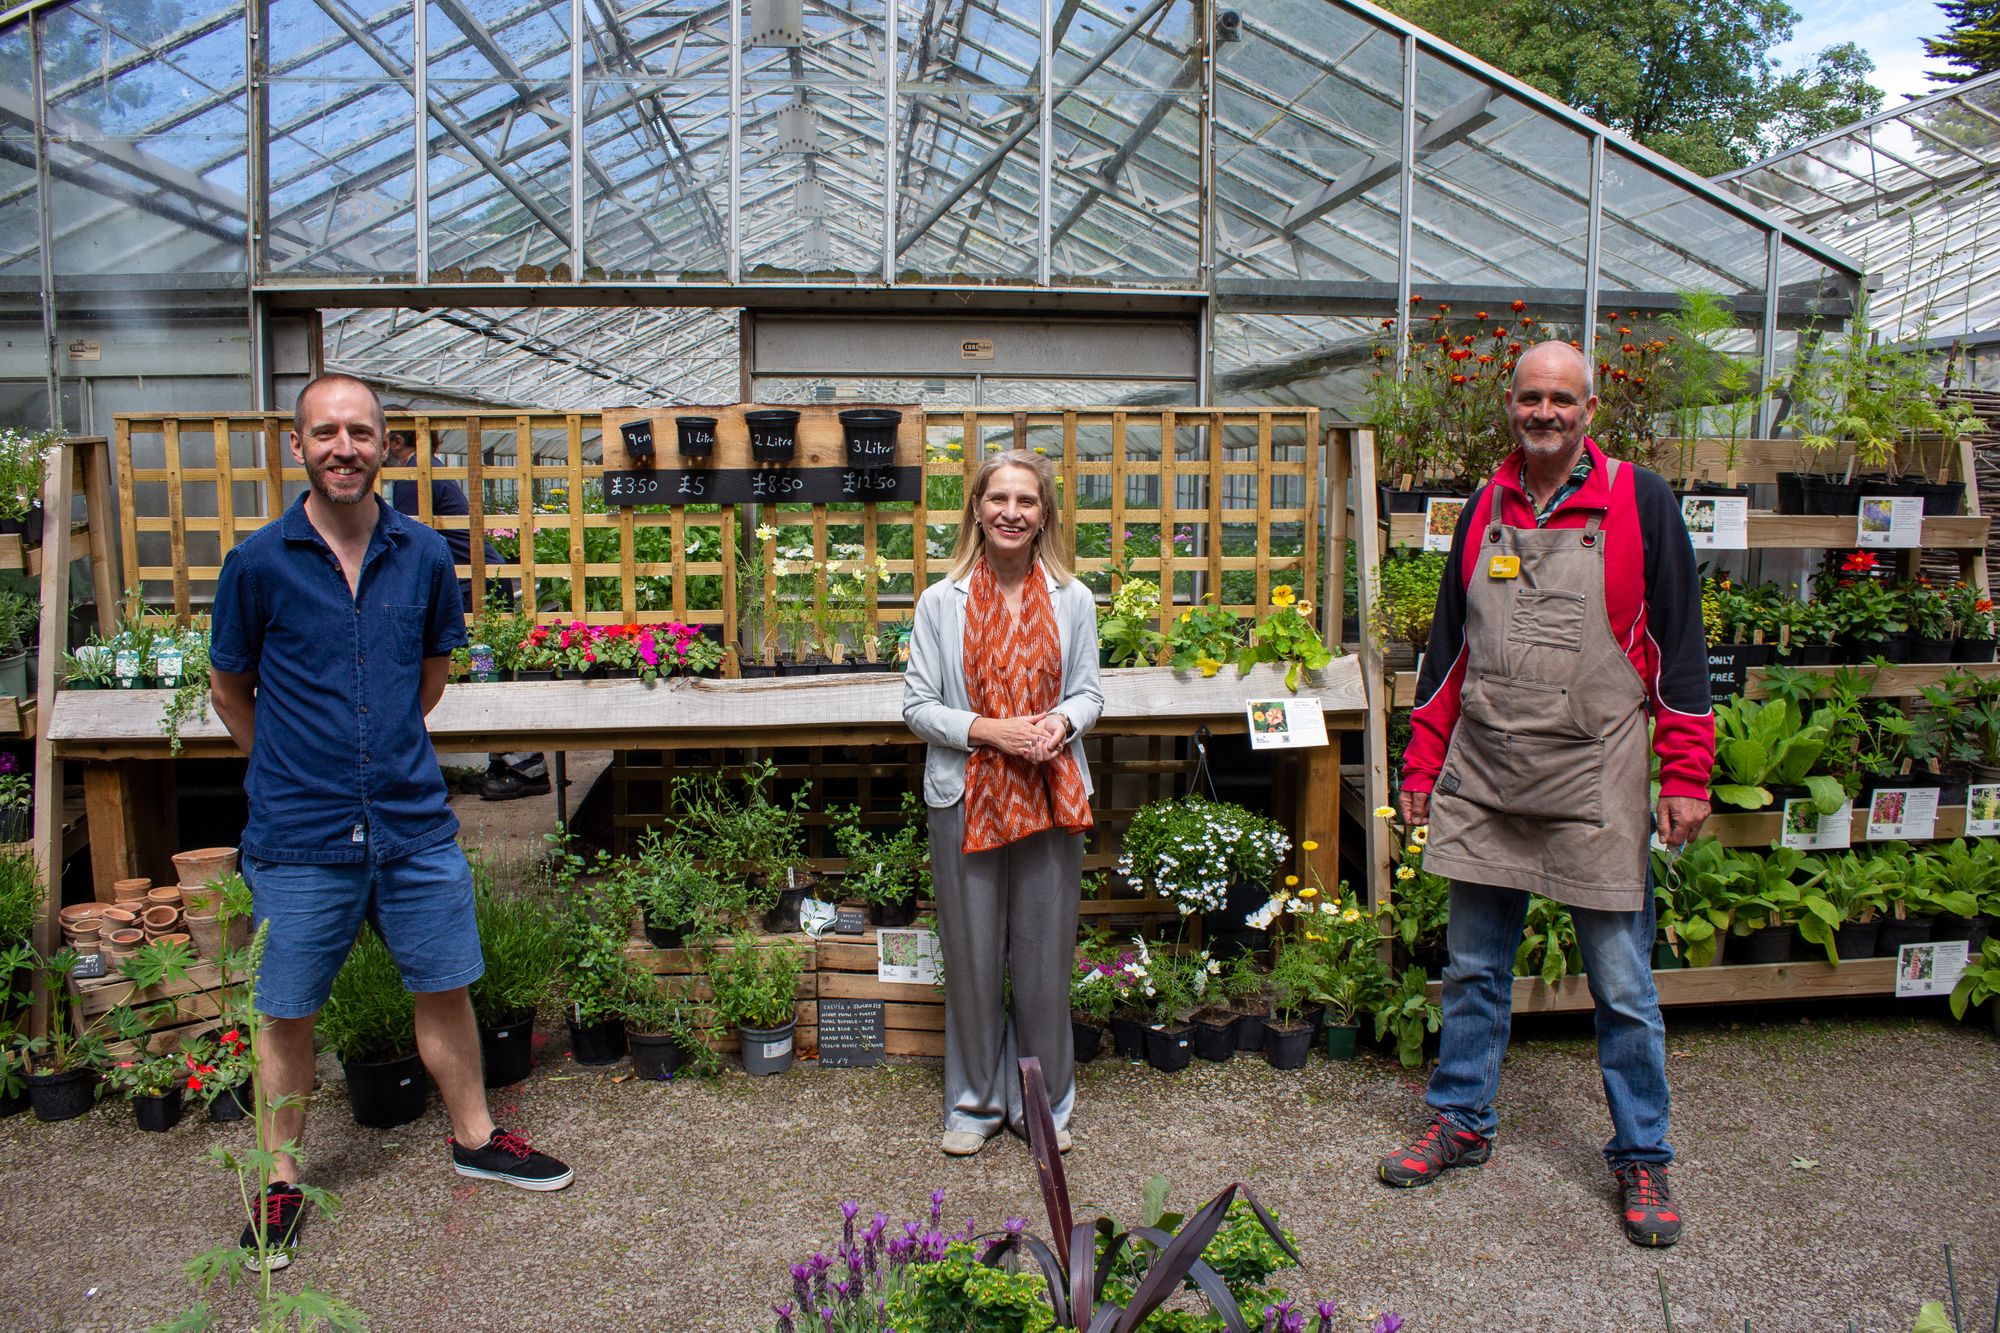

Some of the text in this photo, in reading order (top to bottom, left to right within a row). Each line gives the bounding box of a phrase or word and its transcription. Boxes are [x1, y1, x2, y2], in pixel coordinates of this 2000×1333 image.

[629, 433, 651, 445] 9cm
[755, 434, 762, 446] 2
[853, 439, 861, 453] 3
[679, 475, 704, 494] £5
[1708, 655, 1735, 665] ONLY
[1710, 672, 1735, 682] FREE
